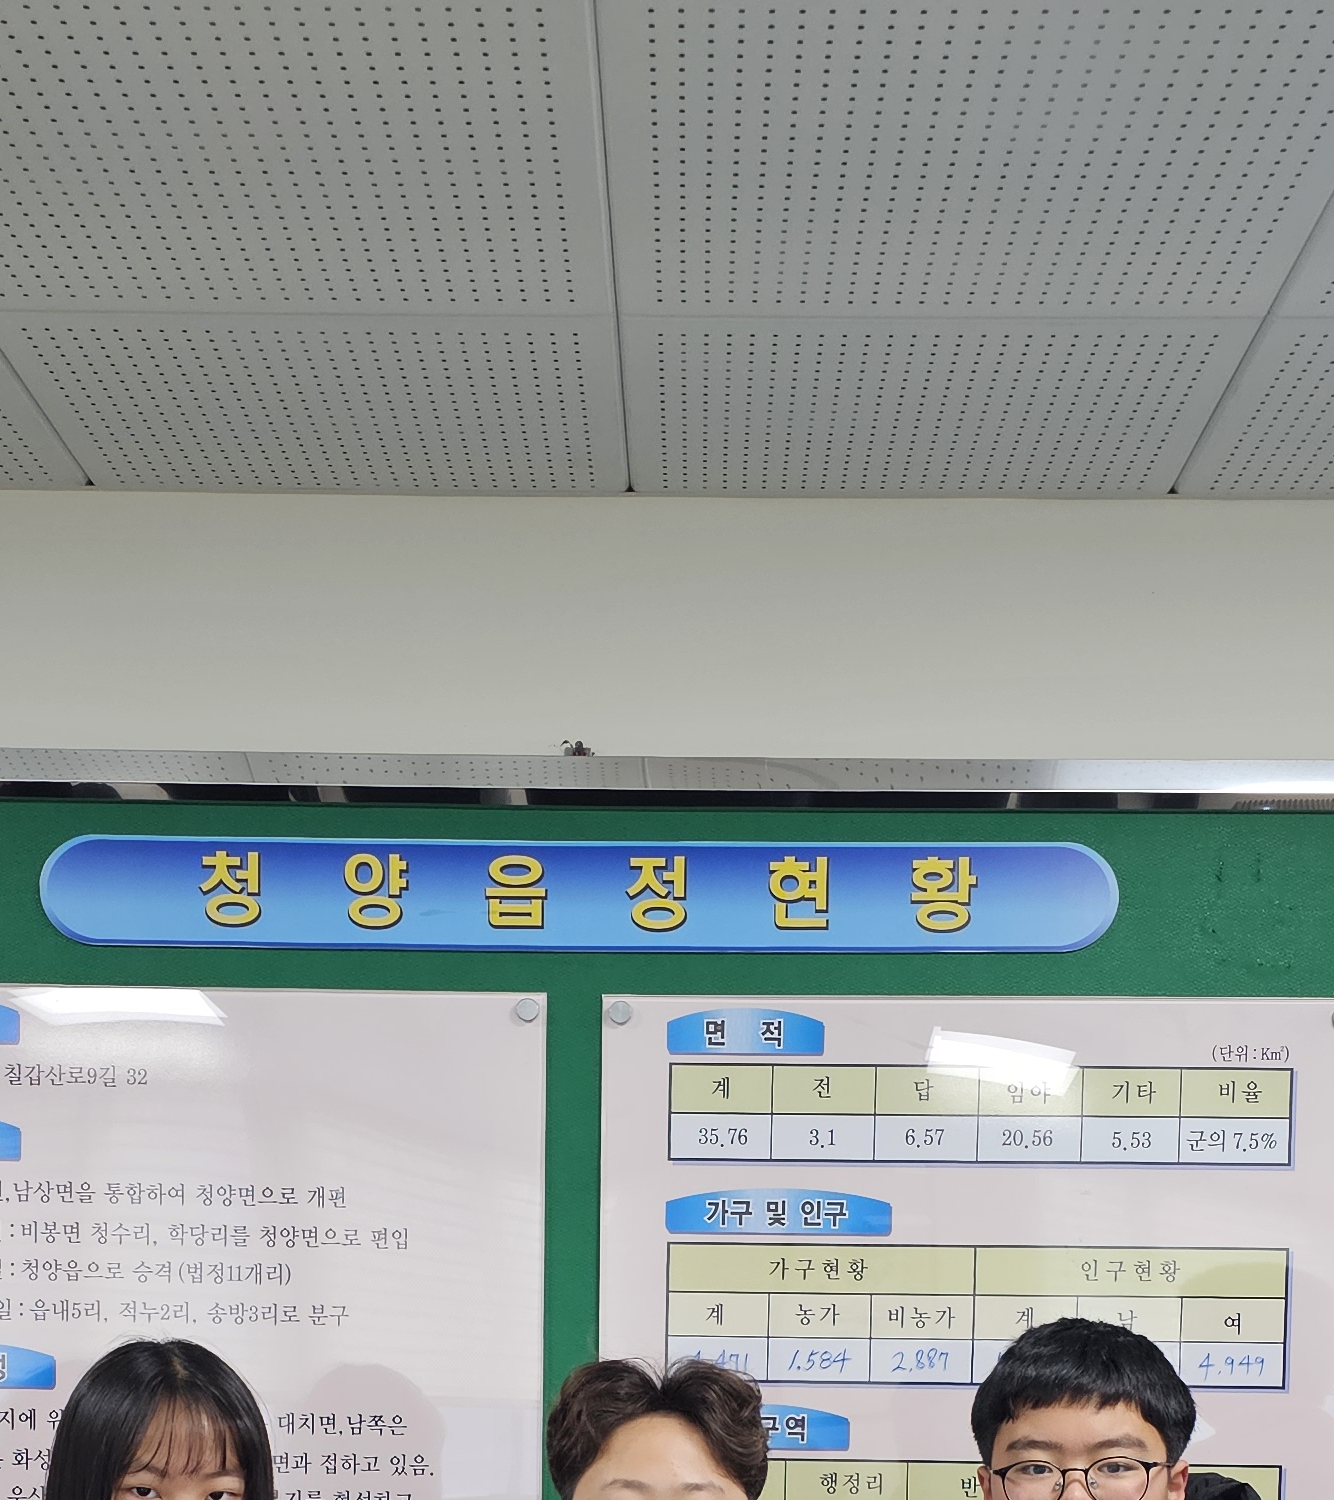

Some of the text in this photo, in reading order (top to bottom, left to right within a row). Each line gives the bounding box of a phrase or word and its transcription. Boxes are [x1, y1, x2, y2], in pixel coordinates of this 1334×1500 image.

[3, 1062, 117, 1088] 칠갑산로9길
[126, 1068, 148, 1086] 32
[711, 1076, 730, 1100] 계
[812, 1076, 832, 1099] 전
[913, 1078, 934, 1102] 답
[1112, 1080, 1157, 1105] 기타
[1218, 1080, 1263, 1104] 비율
[698, 1127, 1278, 1153] 35.76 3.1 6.57 20.56 5.53 군의 7.5%
[103, 1182, 185, 1207] 통합하여
[196, 1183, 299, 1207] 청양면으로
[307, 1185, 347, 1209] 개편
[706, 1199, 847, 1228] 가구 및 인구
[20, 1220, 82, 1244] 비봉면
[90, 1221, 158, 1247] 청수리,
[167, 1223, 251, 1248] 학당리를
[259, 1224, 362, 1249] 청양면으로
[370, 1227, 408, 1250] 편입
[21, 1258, 125, 1282] 청양읍으로
[206, 1302, 301, 1327] 송방3리로
[307, 1303, 350, 1327] 분구
[705, 1302, 724, 1326] 계
[794, 1303, 841, 1327] 농가
[887, 1305, 956, 1330] 비농가
[1223, 1312, 1241, 1336] 여
[788, 1348, 851, 1373] 1.584
[320, 1452, 381, 1476] 접하고
[389, 1453, 434, 1477] 있음.
[819, 1471, 883, 1496] 행정리
